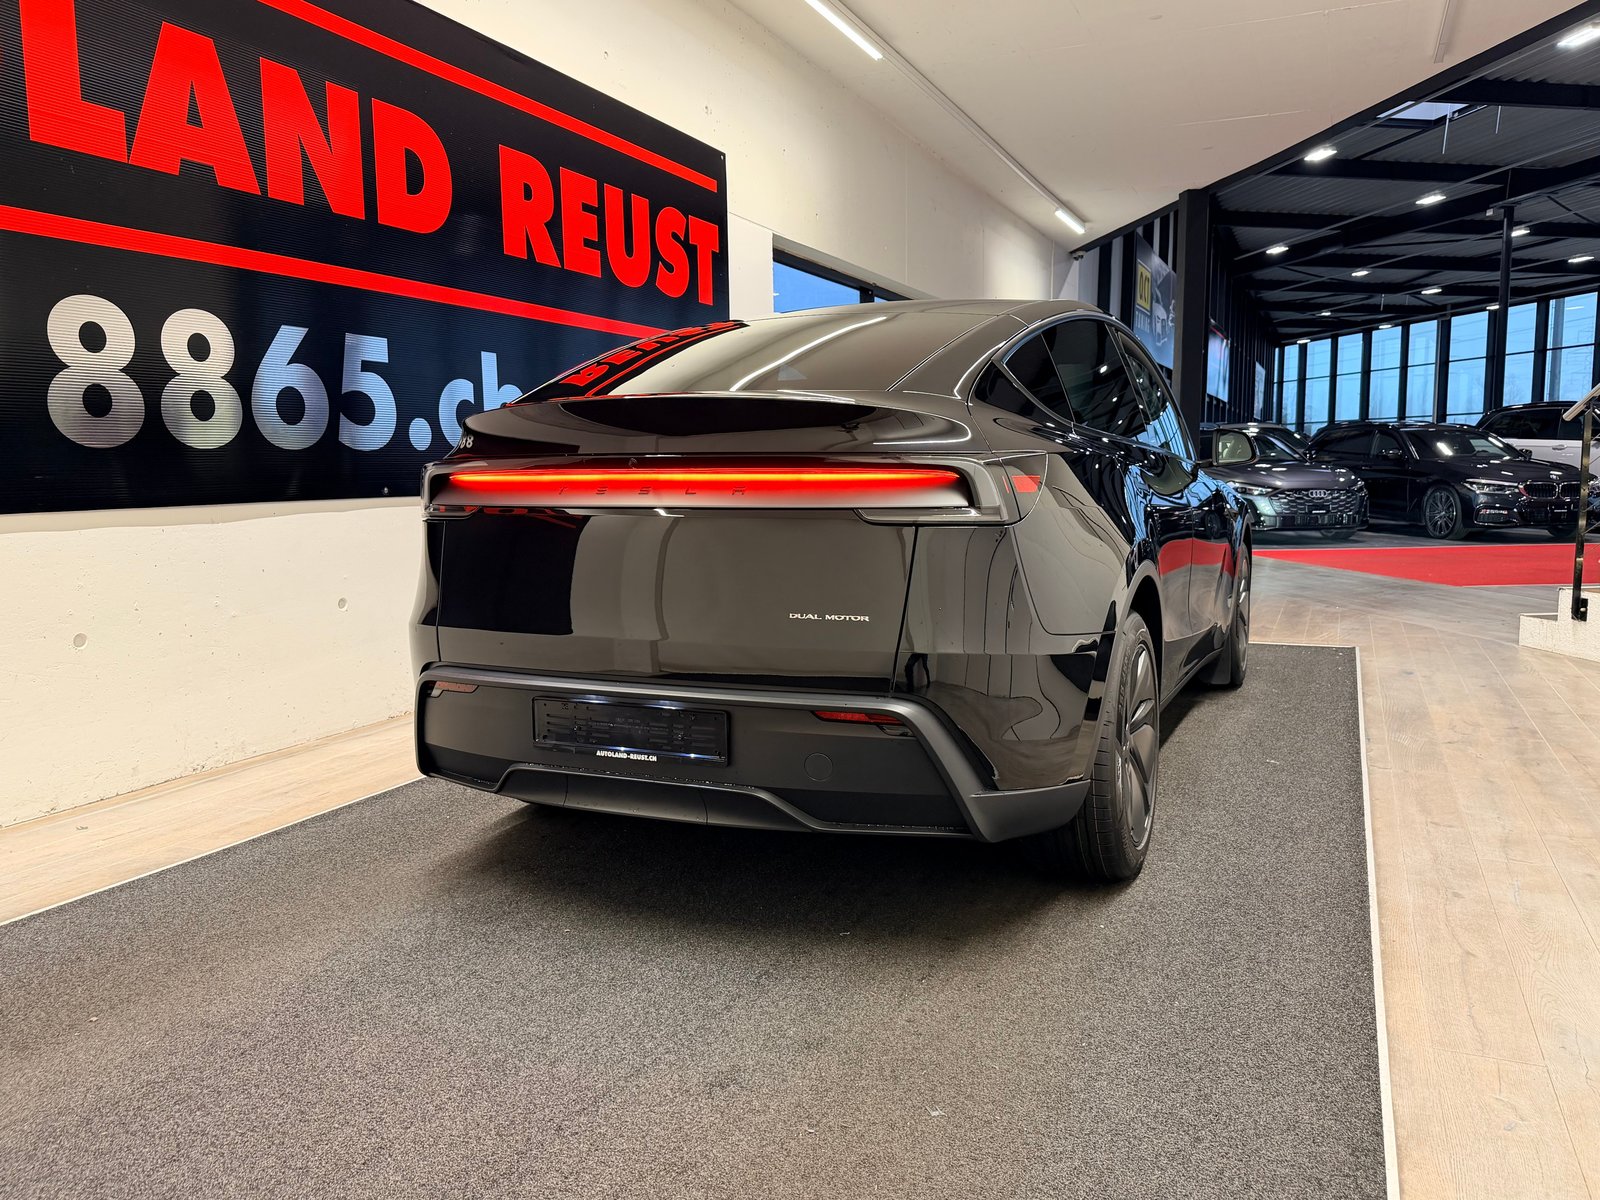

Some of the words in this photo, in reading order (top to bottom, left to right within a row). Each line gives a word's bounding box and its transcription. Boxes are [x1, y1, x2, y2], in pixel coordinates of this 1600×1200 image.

[499, 144, 719, 305] REUST
[558, 486, 747, 496] TESLA
[825, 614, 870, 622] MOTOR
[596, 749, 658, 762] AUTOLAND-REUST.CH
